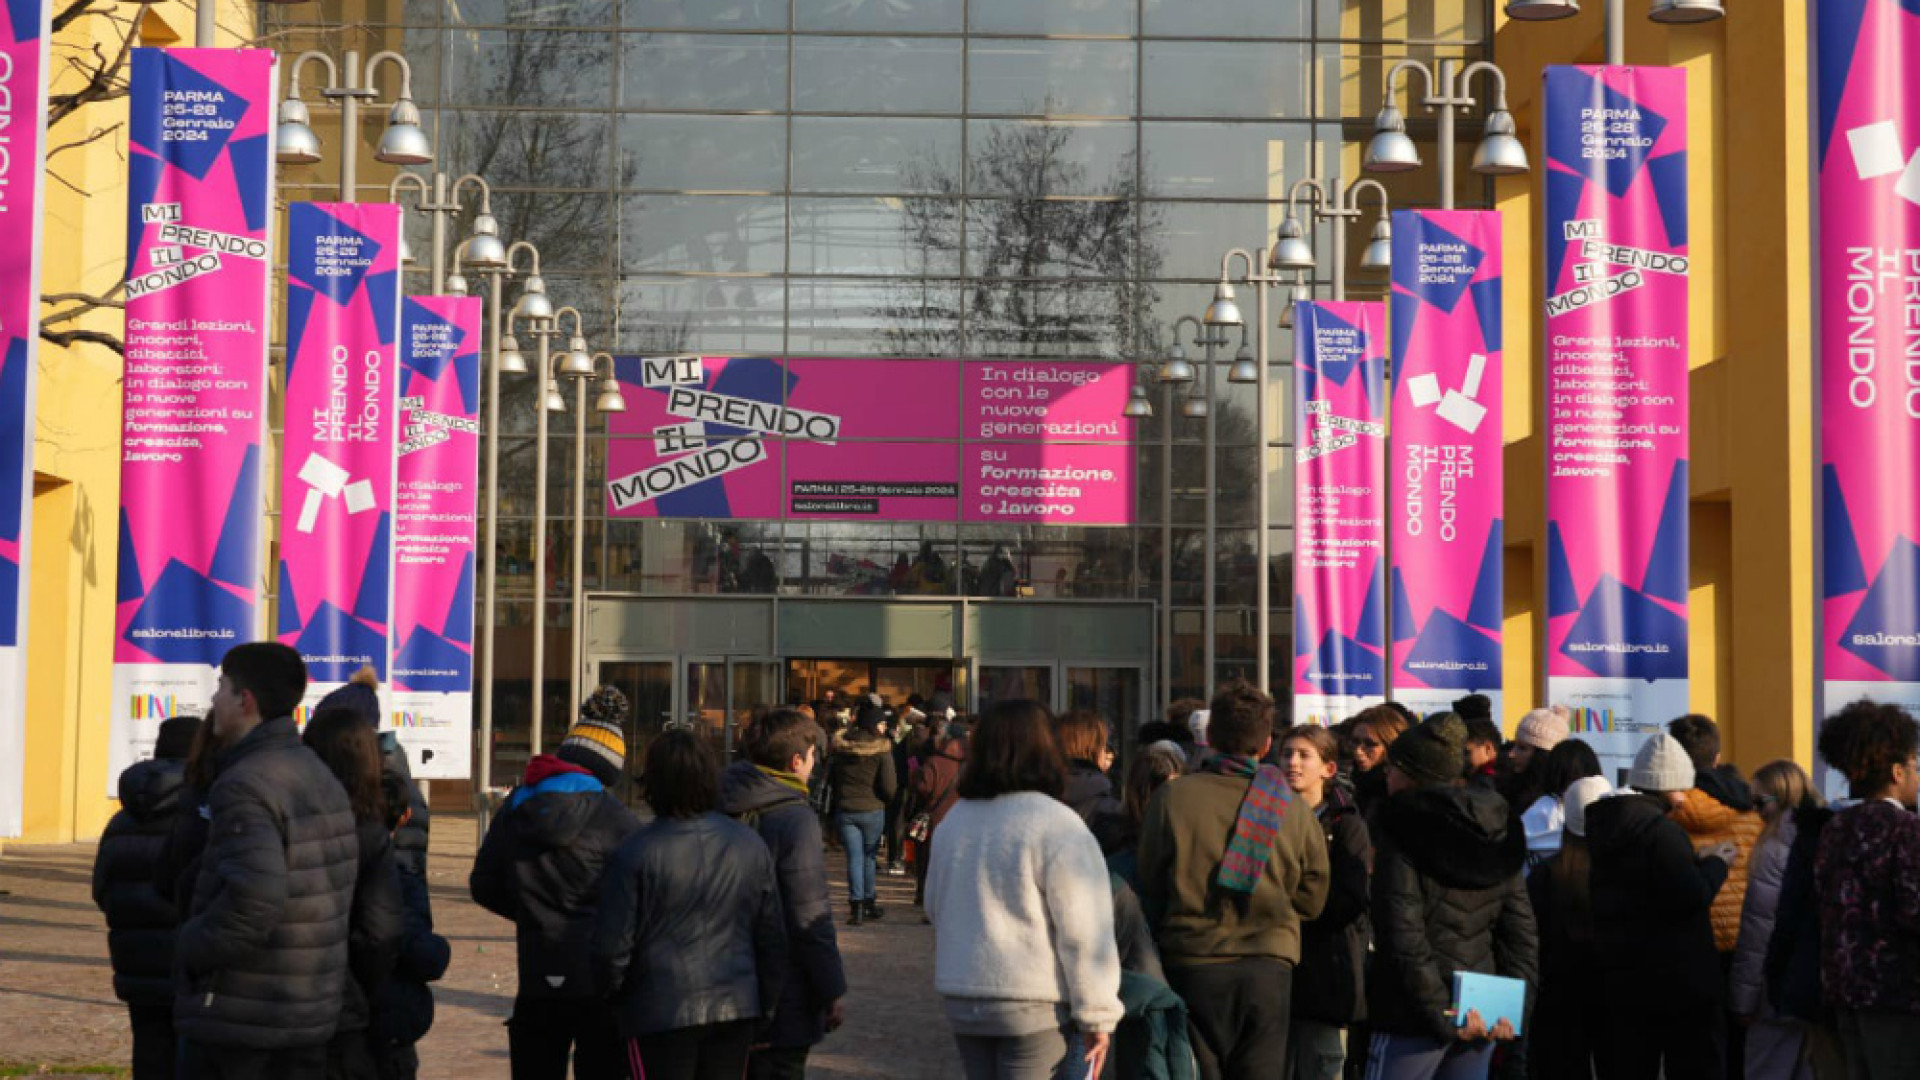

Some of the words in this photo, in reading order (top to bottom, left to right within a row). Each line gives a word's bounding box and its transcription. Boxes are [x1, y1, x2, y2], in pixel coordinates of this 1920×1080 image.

[164, 92, 224, 102] PARMA
[163, 104, 217, 116] 25-28
[1582, 109, 1642, 120] PARMA
[163, 118, 234, 129] Gennaio
[163, 130, 208, 140] 2024
[1582, 134, 1653, 146] Gennaio
[1582, 148, 1627, 159] 2024
[144, 206, 180, 220] MI
[1566, 222, 1598, 238] MI
[161, 225, 266, 258] PRENDO
[316, 236, 364, 246] PARMA
[153, 248, 182, 264] IL
[1419, 244, 1467, 254] PARMA
[315, 256, 372, 266] Gennaio
[1583, 241, 1688, 273] PRENDO
[126, 254, 218, 297] MONDO
[1419, 264, 1476, 274] Gennaio
[1576, 265, 1596, 281] IL
[1878, 246, 1900, 294] IL
[1419, 274, 1456, 283] 2024
[1548, 272, 1640, 315] MONDO
[128, 318, 187, 330] Grandi
[191, 320, 255, 334] lezioni,
[412, 324, 452, 332] PARMA
[1847, 246, 1876, 408] MONDO
[128, 334, 203, 346] incontri,
[1553, 336, 1611, 346] Grandi
[1615, 336, 1680, 350] lezioni,
[644, 358, 700, 384] MI
[981, 367, 1008, 381] In
[1012, 367, 1101, 386] dialogo
[128, 378, 143, 388] in
[148, 378, 212, 391] dialogo
[215, 380, 248, 389] con
[128, 393, 143, 402] le
[148, 394, 196, 404] nuove
[330, 344, 348, 442] PRENDO
[364, 350, 380, 442] MONDO
[980, 387, 1022, 400] con
[1026, 385, 1049, 400] le
[1554, 393, 1571, 404] in
[1576, 393, 1638, 408] dialogo
[1642, 396, 1675, 404] con
[126, 408, 228, 420] generazioni
[232, 410, 252, 418] su
[670, 389, 837, 440] PRENDO
[980, 406, 1048, 417] nuove
[1554, 408, 1570, 418] le
[1576, 410, 1623, 419] nuove
[126, 422, 228, 434] formazione,
[313, 407, 329, 441] MI
[348, 414, 362, 441] IL
[980, 420, 1119, 438] generazioni
[1554, 422, 1656, 438] generazioni
[1658, 426, 1678, 434] su
[124, 436, 203, 449] crescita,
[656, 426, 704, 454] IL
[1554, 436, 1655, 450] formazione,
[124, 451, 183, 462] lavoro
[980, 450, 1007, 461] su
[1424, 444, 1438, 472] IL
[1458, 444, 1474, 478] MI
[1554, 452, 1631, 464] crescita,
[611, 438, 761, 506] MONDO
[980, 464, 1118, 482] formazione,
[1553, 466, 1610, 476] lavoro
[794, 484, 834, 494] PARMA
[980, 482, 1082, 498] crescita
[1406, 444, 1423, 536] MONDO
[1440, 444, 1456, 542] PRENDO
[980, 502, 994, 514] e
[997, 500, 1076, 514] lavoro
[132, 628, 235, 638] salonelibro.it
[1568, 642, 1670, 653] salonelibro.it
[1408, 661, 1488, 670] salonelibro.it
